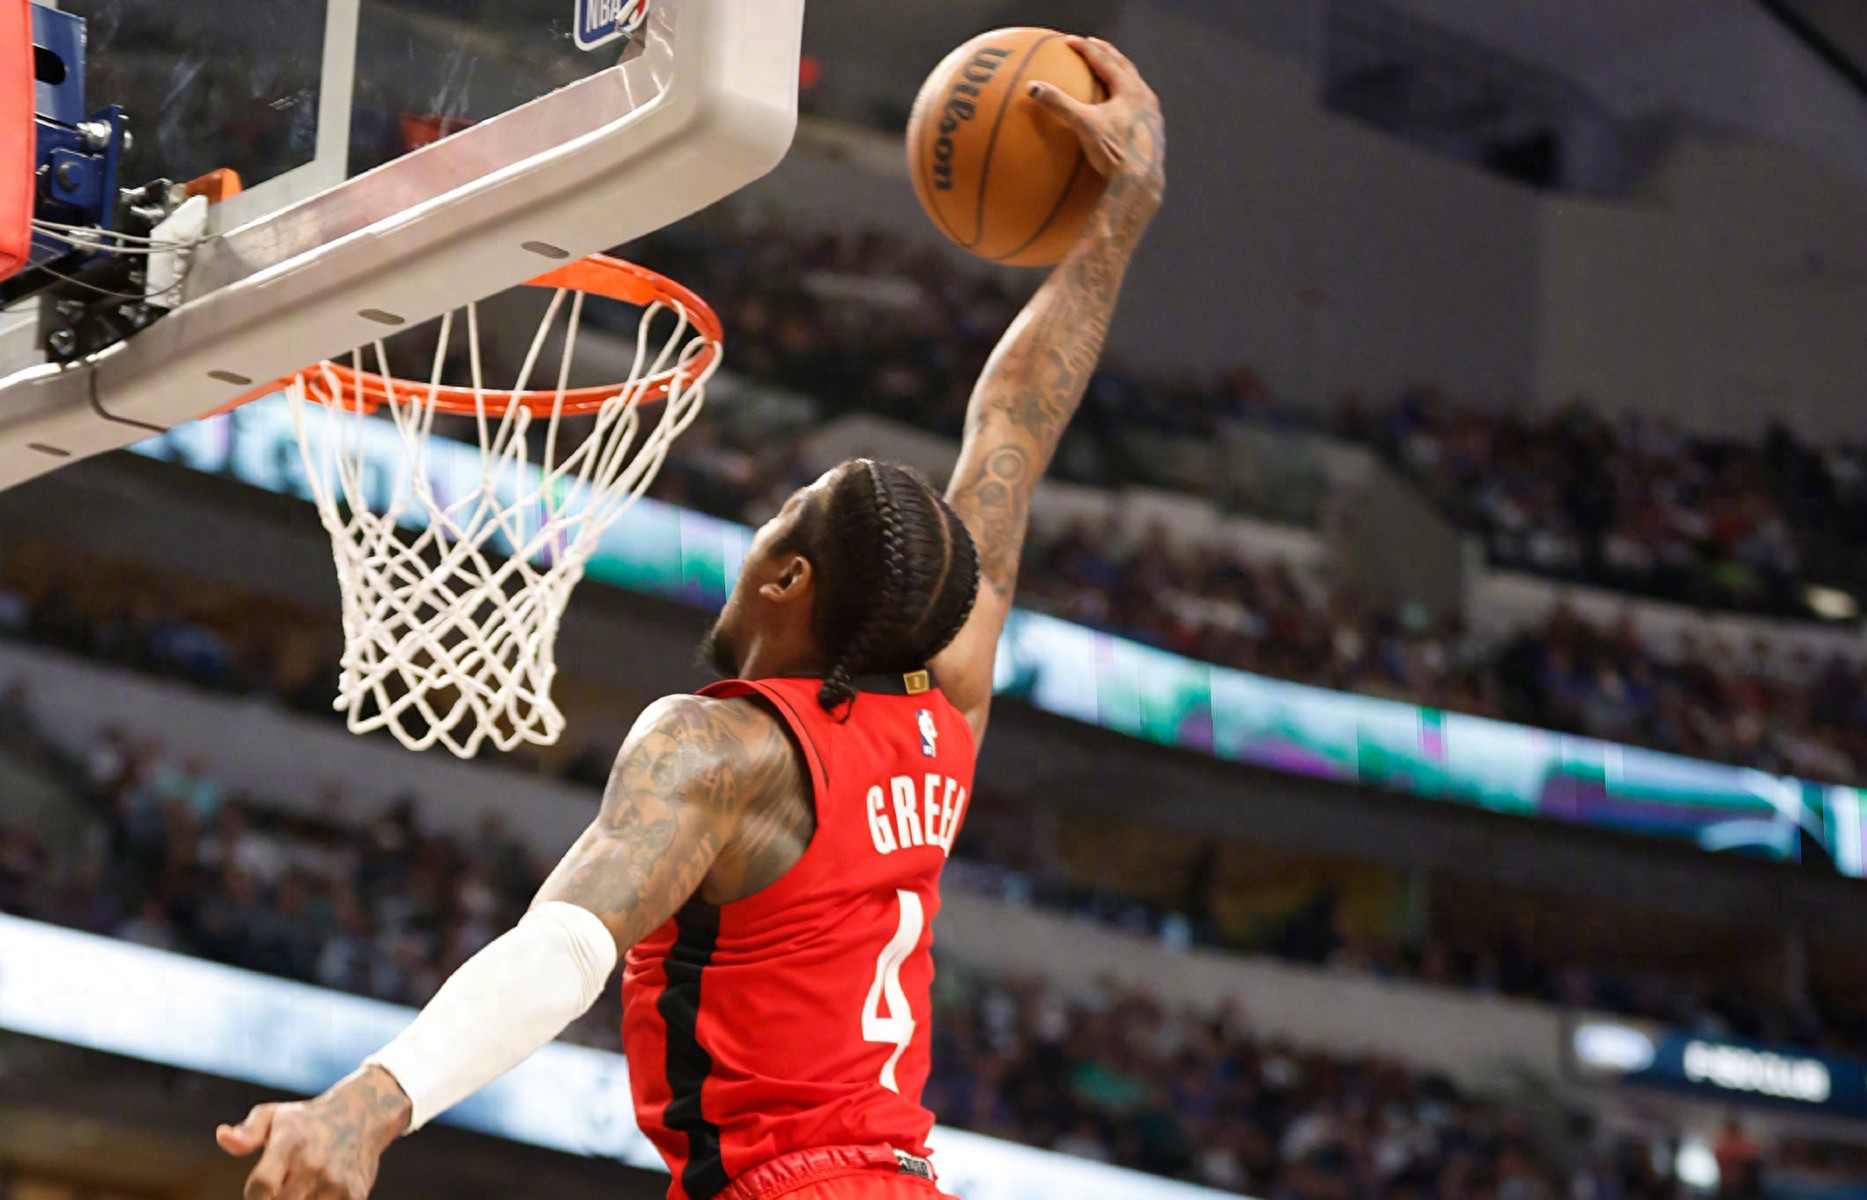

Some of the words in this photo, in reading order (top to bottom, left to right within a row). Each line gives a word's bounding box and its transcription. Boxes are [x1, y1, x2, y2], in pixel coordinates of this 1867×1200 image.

[585, 0, 621, 33] NBA
[934, 48, 1014, 191] Wilson
[861, 888, 924, 1094] 4
